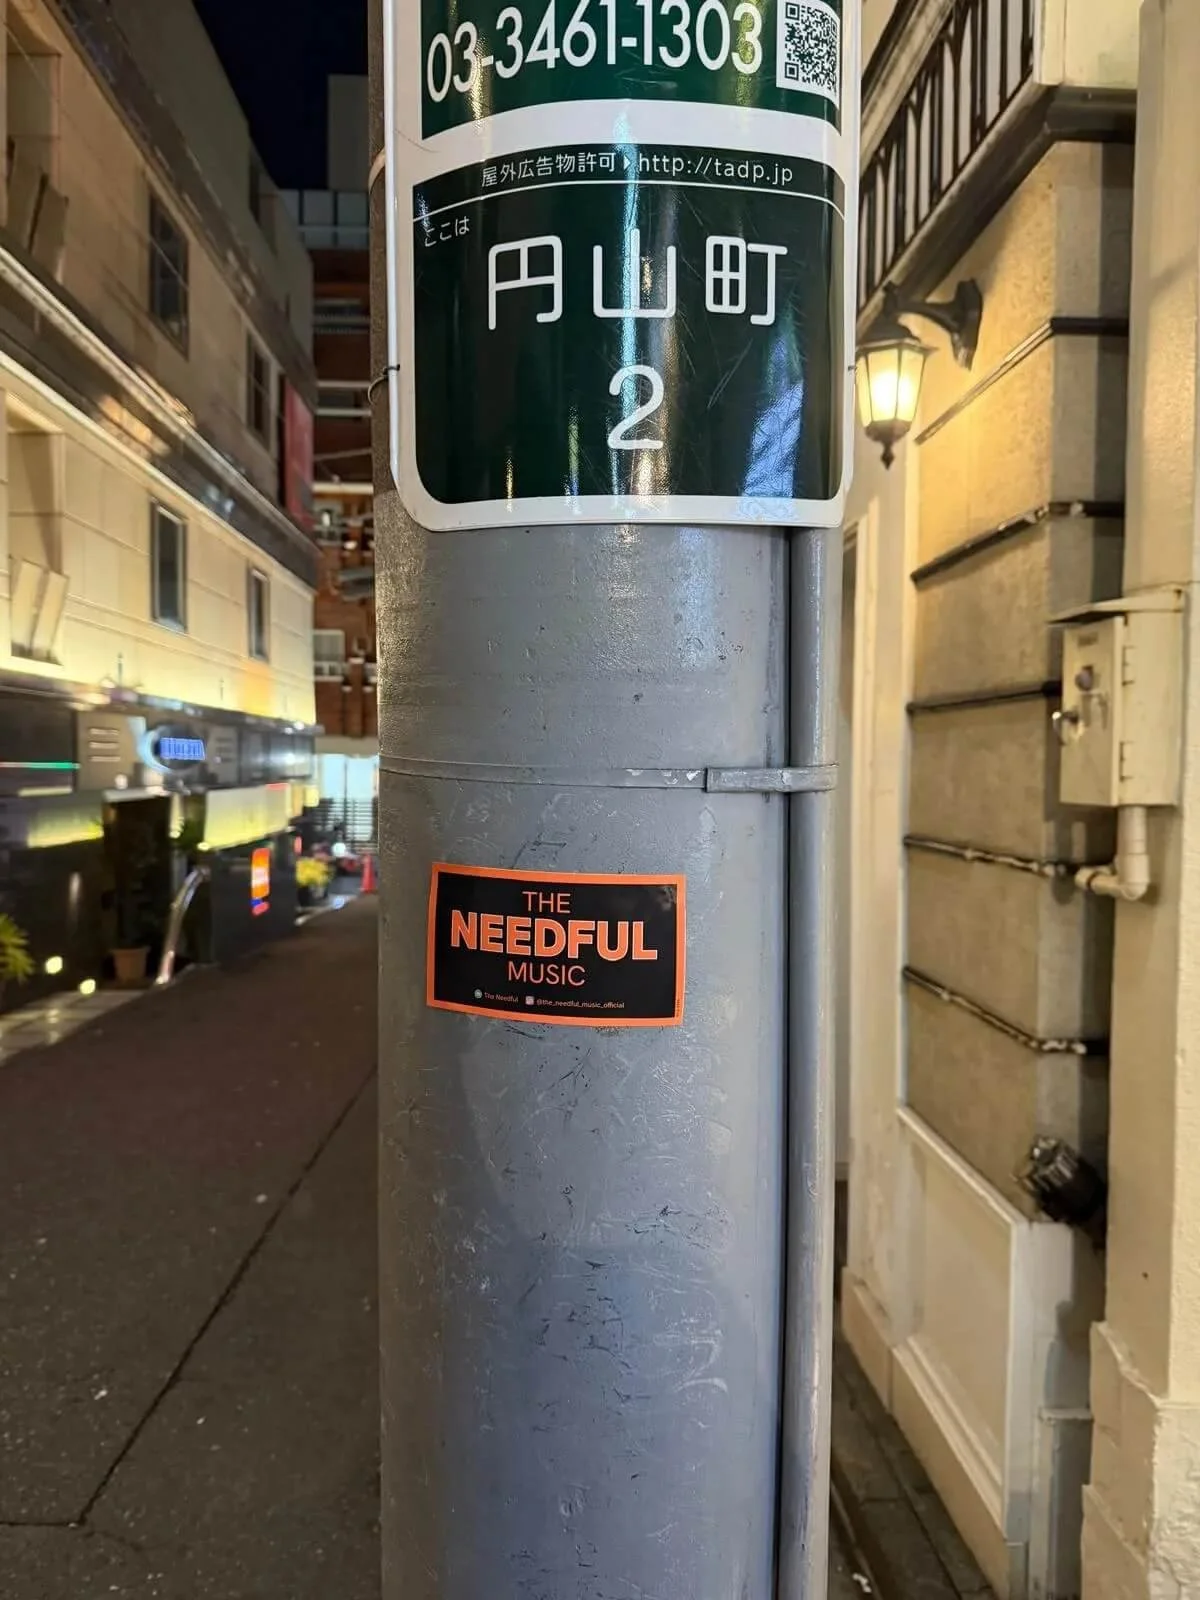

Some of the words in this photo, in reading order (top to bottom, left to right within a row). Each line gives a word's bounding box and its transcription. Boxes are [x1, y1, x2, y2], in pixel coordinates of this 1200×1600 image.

[427, 0, 763, 102] 03-3461-1303
[481, 152, 616, 187] 屋外広告物許可
[639, 153, 793, 186] http://tadp.jp
[424, 216, 470, 247] ここは
[488, 228, 788, 330] 円山町
[607, 365, 664, 450] 2
[522, 891, 571, 914] THE
[451, 910, 658, 961] NEEDFUL
[508, 961, 586, 986] MUSIC
